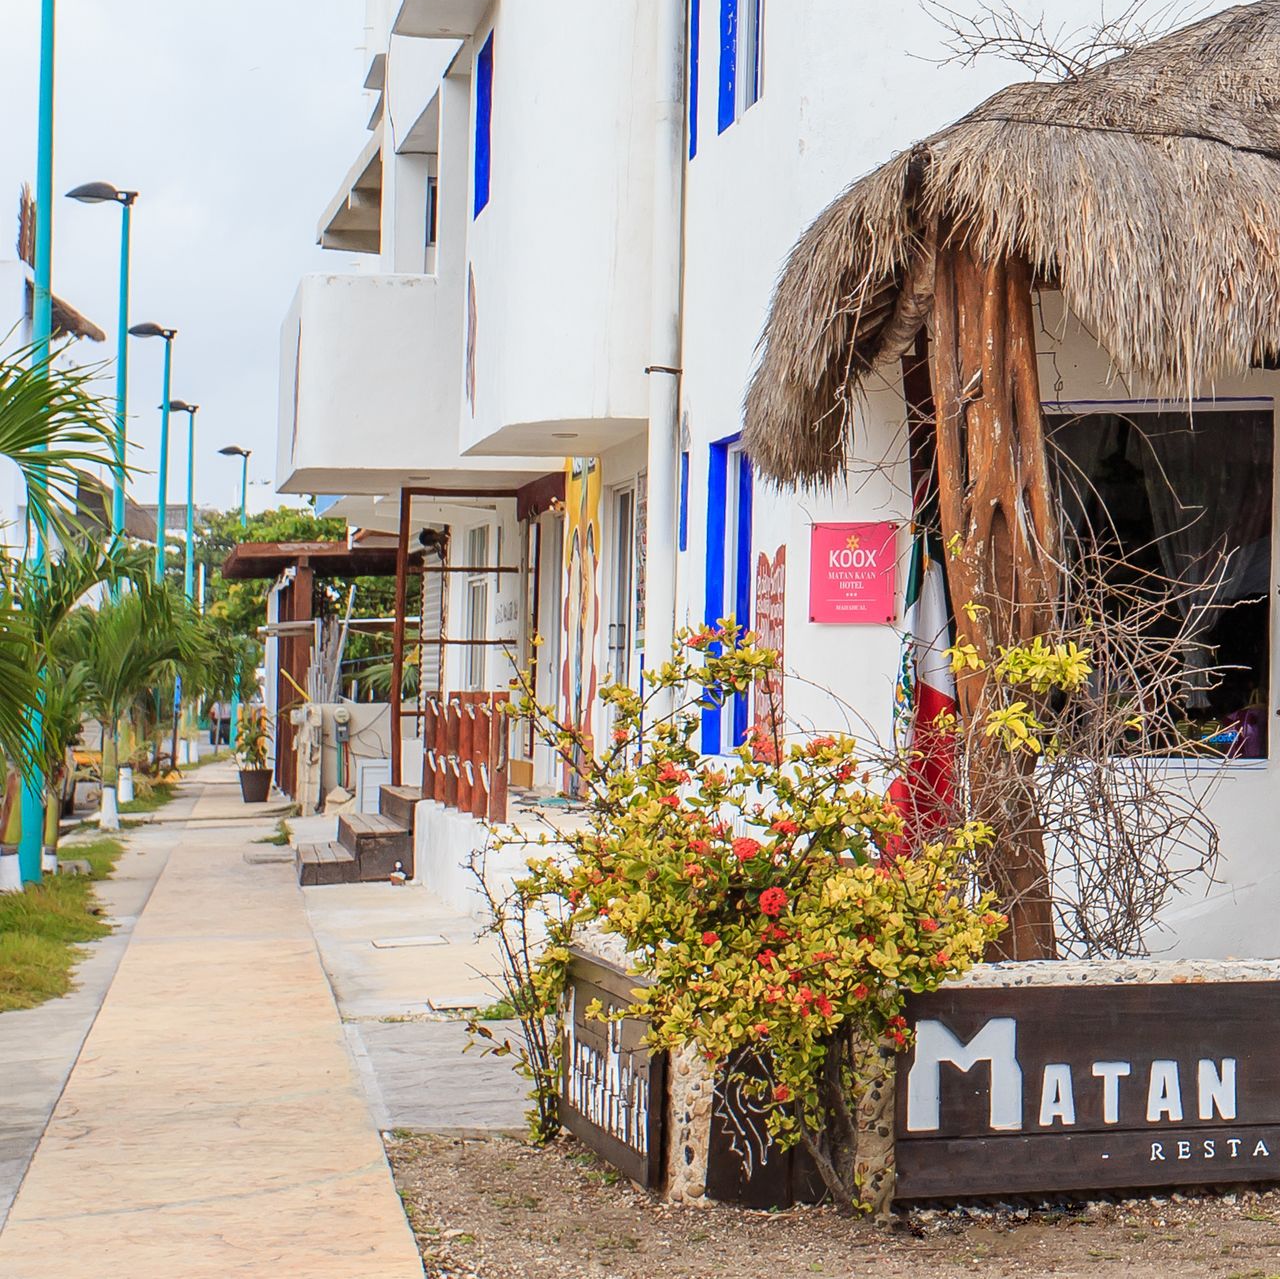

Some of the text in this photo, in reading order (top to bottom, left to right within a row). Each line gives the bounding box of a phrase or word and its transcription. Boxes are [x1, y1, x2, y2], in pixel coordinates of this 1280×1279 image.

[829, 549, 877, 568] KOOX
[839, 581, 864, 589] HOTEL
[906, 1017, 1238, 1132] MATAN
